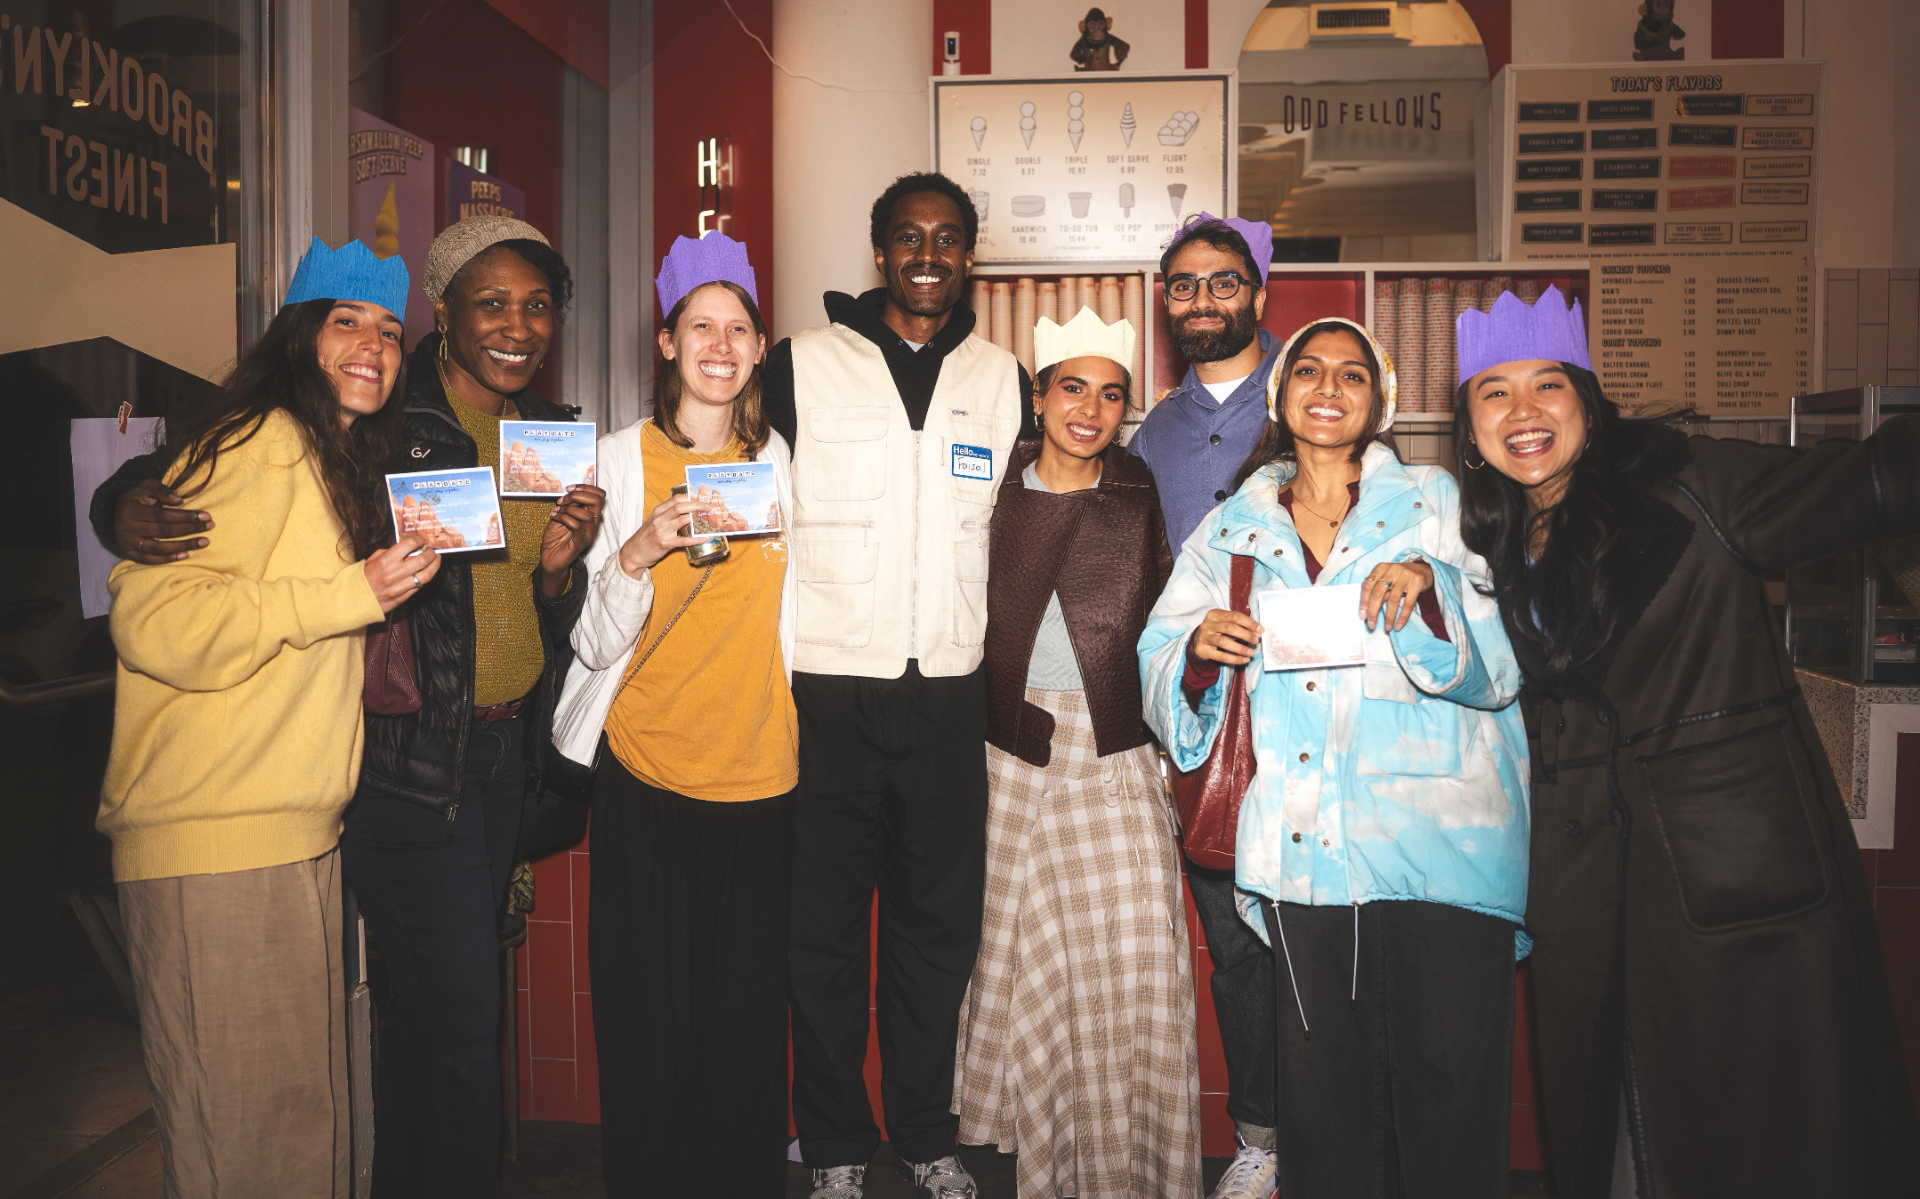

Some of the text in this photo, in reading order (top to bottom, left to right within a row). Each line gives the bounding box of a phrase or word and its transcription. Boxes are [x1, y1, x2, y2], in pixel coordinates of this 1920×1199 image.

[1610, 75, 1722, 92] TODAY'S FLAVORS
[1284, 92, 1441, 134] ODD FELLOWS
[348, 130, 423, 160] RSHMALLOW PEEP
[967, 158, 991, 166] SINGLE
[1015, 156, 1042, 165] DOUBLE
[1064, 156, 1088, 164] TRIPLE
[1106, 155, 1150, 163] SOFT SERVE
[1162, 154, 1187, 162] FLIGHT
[356, 154, 406, 184] SOFT SERVE
[972, 168, 987, 176] 7.12
[1021, 168, 1035, 176] 9.31
[1068, 167, 1086, 175] 10.92
[1166, 166, 1184, 174] 12.05
[471, 181, 501, 202] PEEPS
[1011, 226, 1047, 234] SANDWICH
[1019, 236, 1037, 244] 10.40
[1602, 265, 1671, 275] CRUNCHY TOPPINGS
[1602, 338, 1661, 347] GOOEY TOPPINGS
[524, 429, 576, 437] PLAYDATE
[953, 446, 973, 456] Hello
[707, 470, 756, 479] PLAYDATE
[413, 479, 471, 489] PLAYDATE
